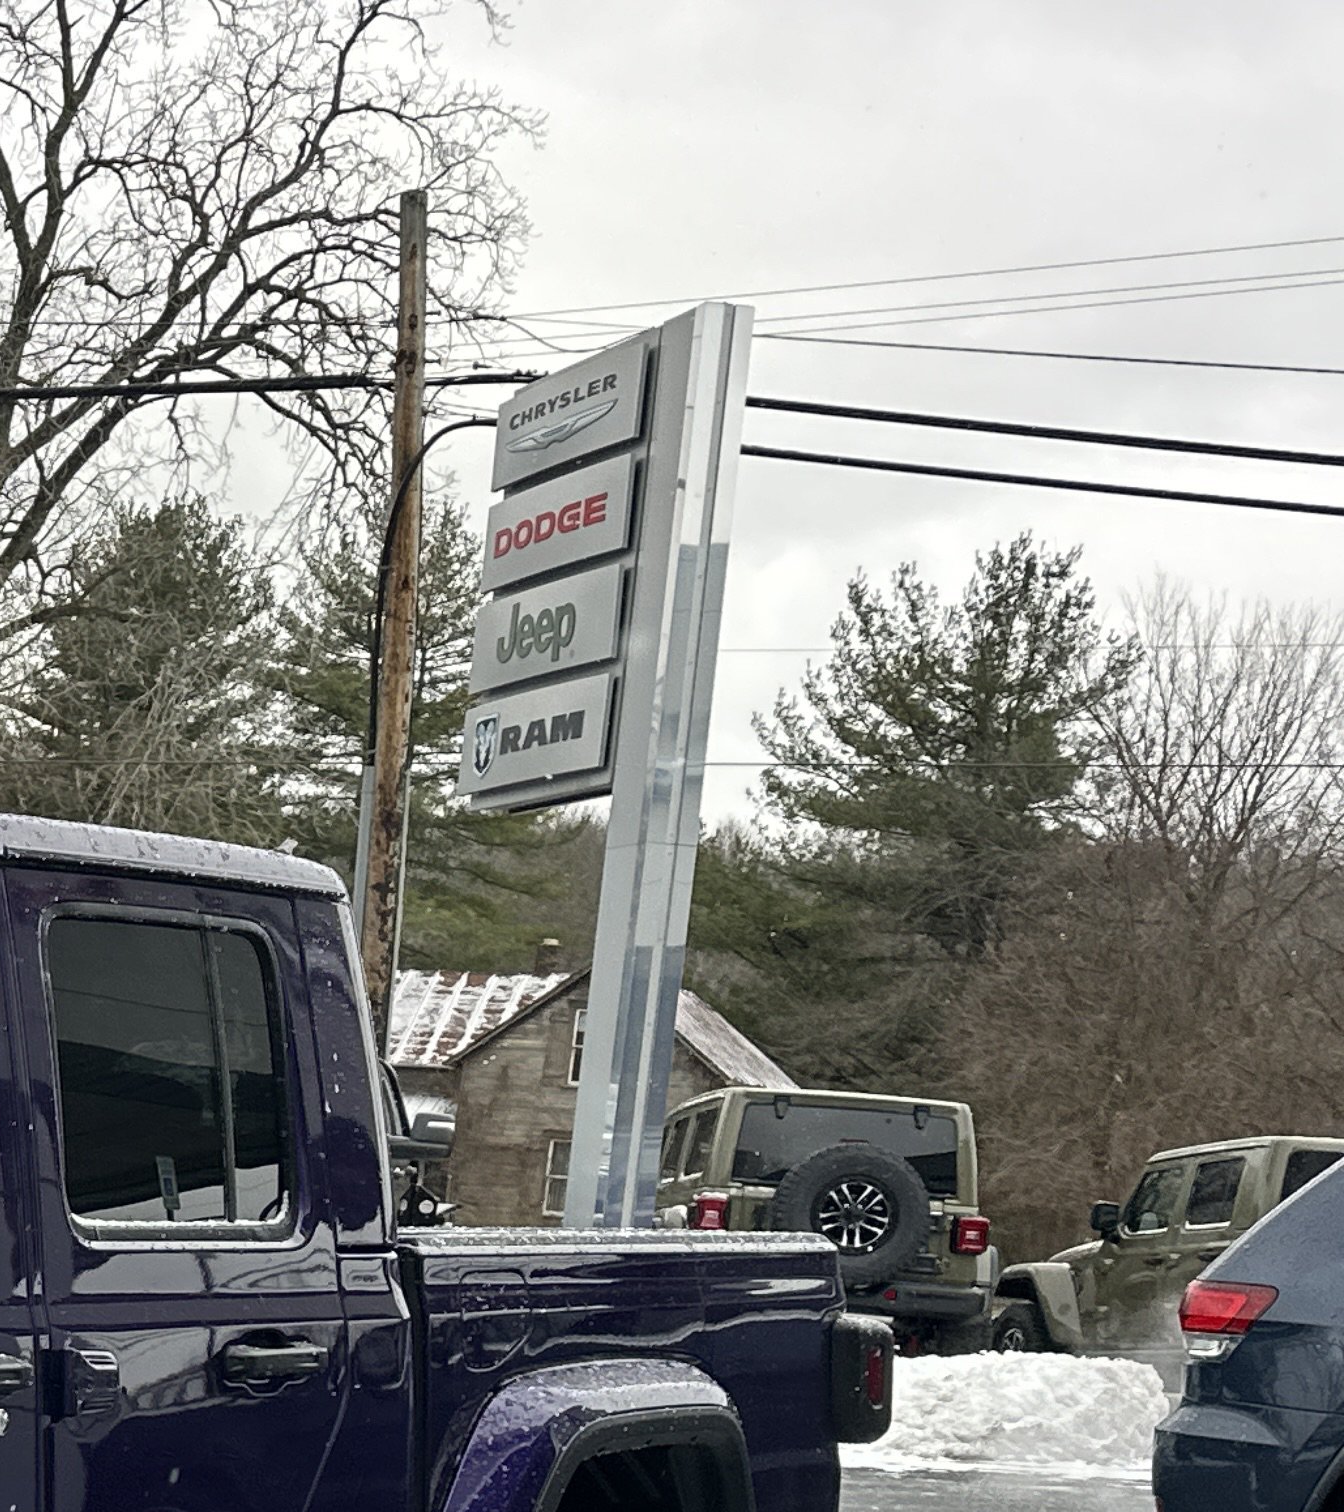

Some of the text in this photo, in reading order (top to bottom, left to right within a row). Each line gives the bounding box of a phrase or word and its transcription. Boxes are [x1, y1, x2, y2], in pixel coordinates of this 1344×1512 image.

[508, 372, 618, 432] CHRYSLER
[493, 492, 608, 559] DODGE
[496, 602, 576, 665] Jeep
[499, 709, 585, 755] RAM
